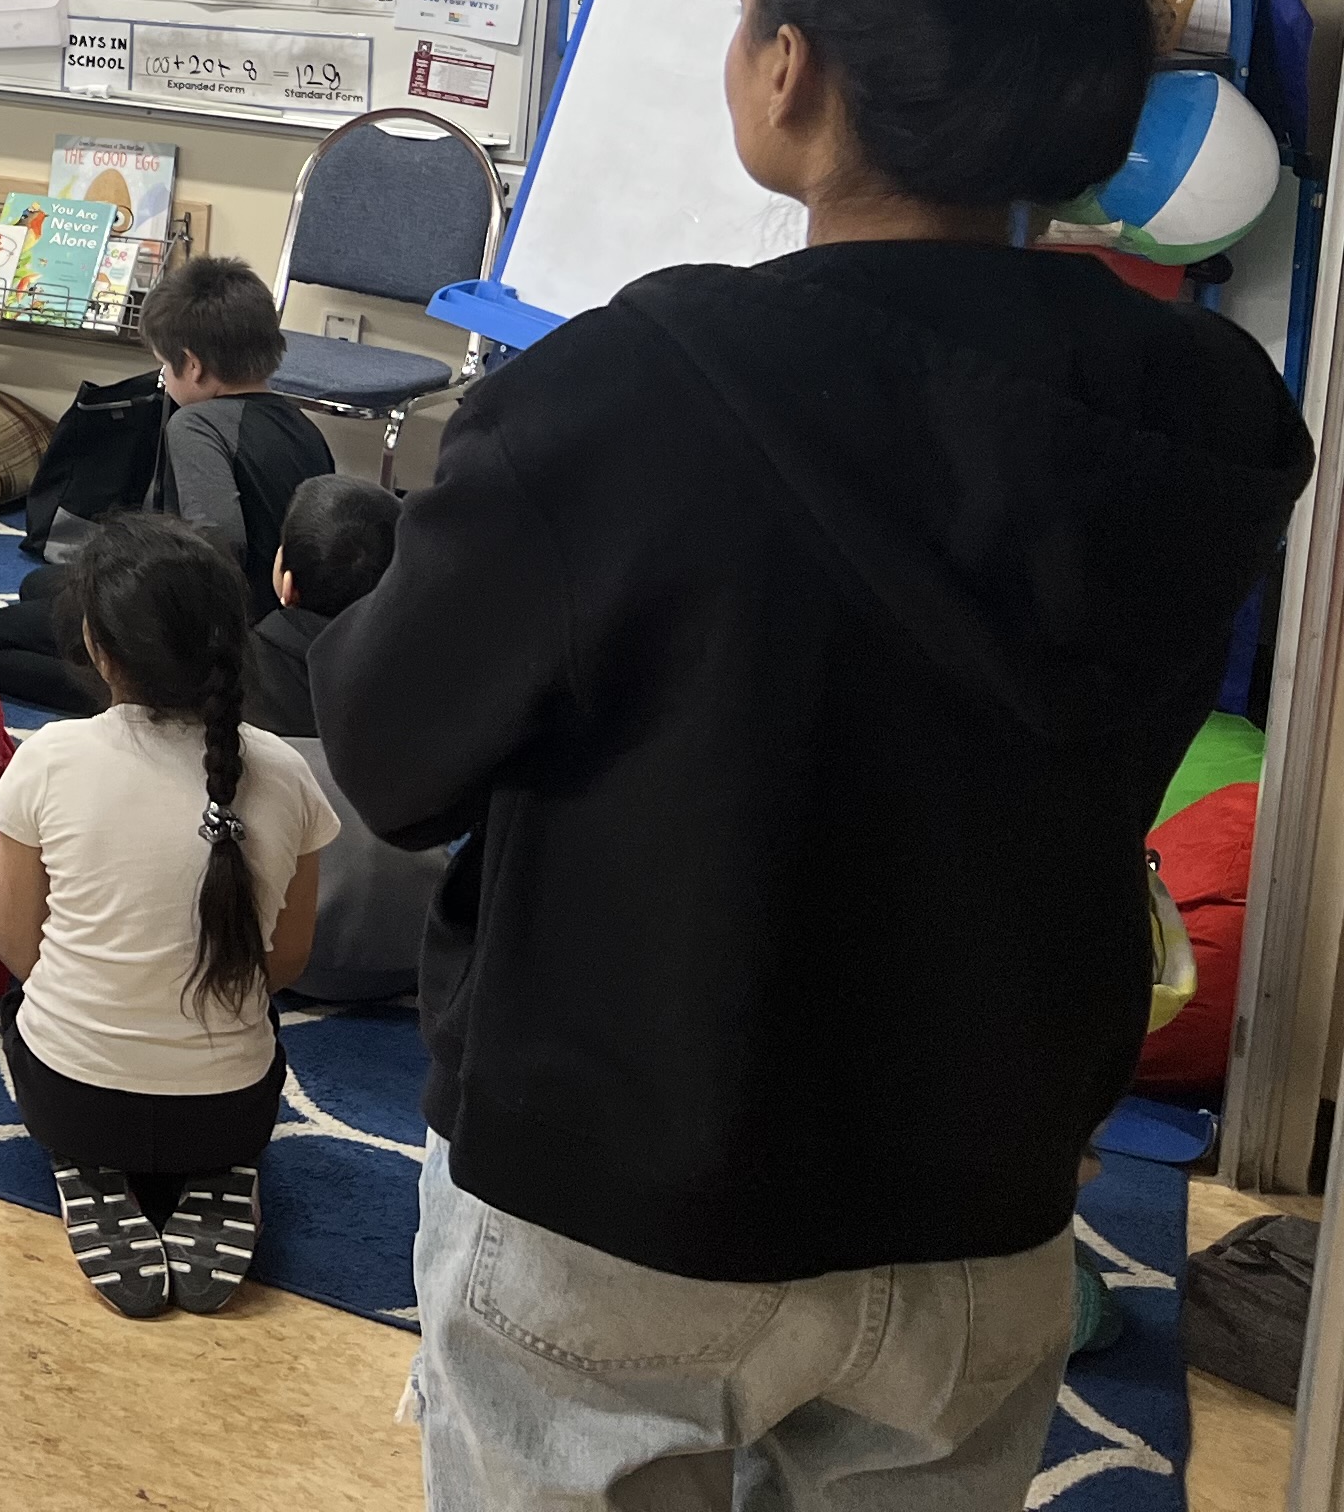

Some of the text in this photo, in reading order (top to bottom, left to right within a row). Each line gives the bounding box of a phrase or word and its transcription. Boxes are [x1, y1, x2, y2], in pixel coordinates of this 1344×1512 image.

[469, 0, 499, 11] WITS!
[69, 33, 127, 51] DAYS IN
[67, 54, 125, 70] SCHOOL
[167, 79, 245, 95] Expanded Form
[284, 88, 363, 104] Standard Form
[64, 147, 160, 172] THE GOOD EGG
[50, 203, 99, 221] You Are
[50, 217, 99, 234] Never
[48, 231, 98, 250] Alone
